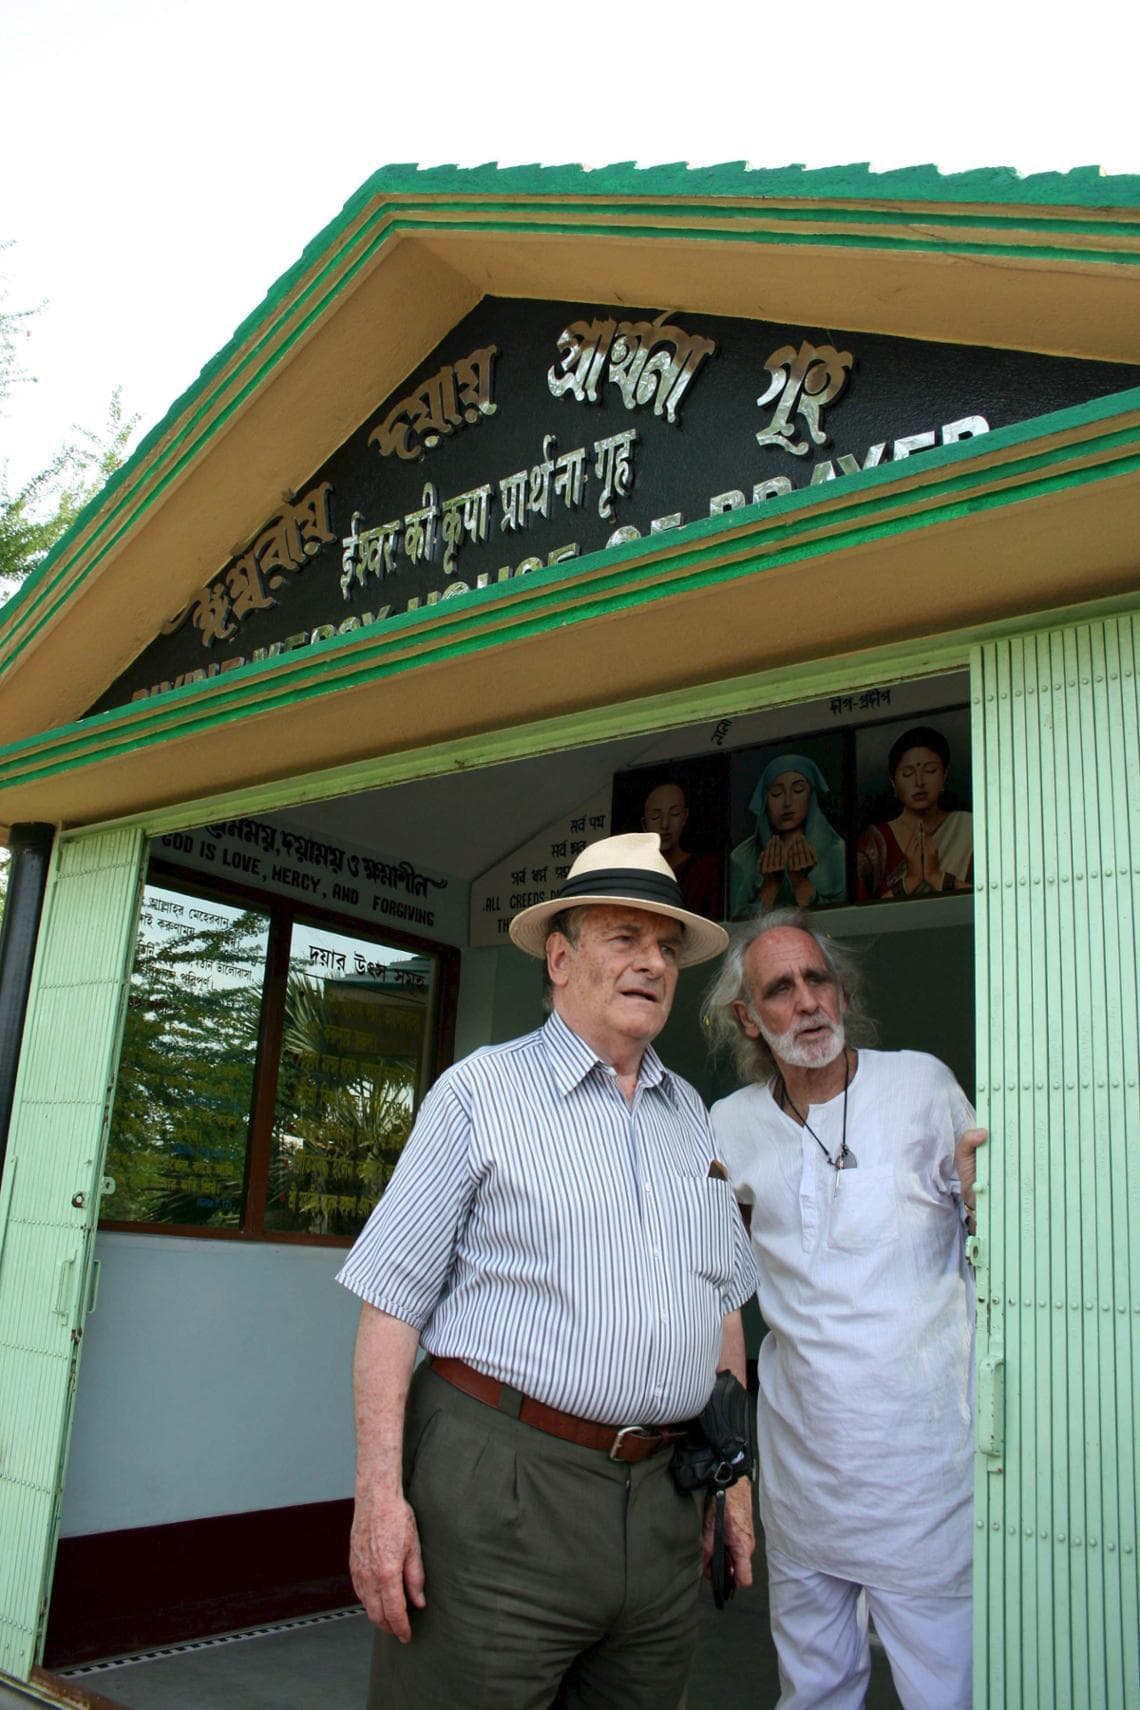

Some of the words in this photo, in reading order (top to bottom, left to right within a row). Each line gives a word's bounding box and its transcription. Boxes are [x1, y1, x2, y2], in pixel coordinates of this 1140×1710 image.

[757, 341, 855, 456] গৃহ
[340, 511, 401, 600] ईश्वर
[404, 482, 440, 564] की
[442, 484, 492, 575] कृपा
[500, 434, 587, 532] प्रार्थना
[594, 428, 638, 523] गृह
[162, 833, 193, 854] GOD
[200, 841, 216, 861] IS
[332, 883, 360, 905] AND
[373, 895, 434, 927] FORGIVING
[347, 855, 360, 878] ও
[309, 945, 346, 971] দয়ার
[353, 951, 387, 982] উৎস
